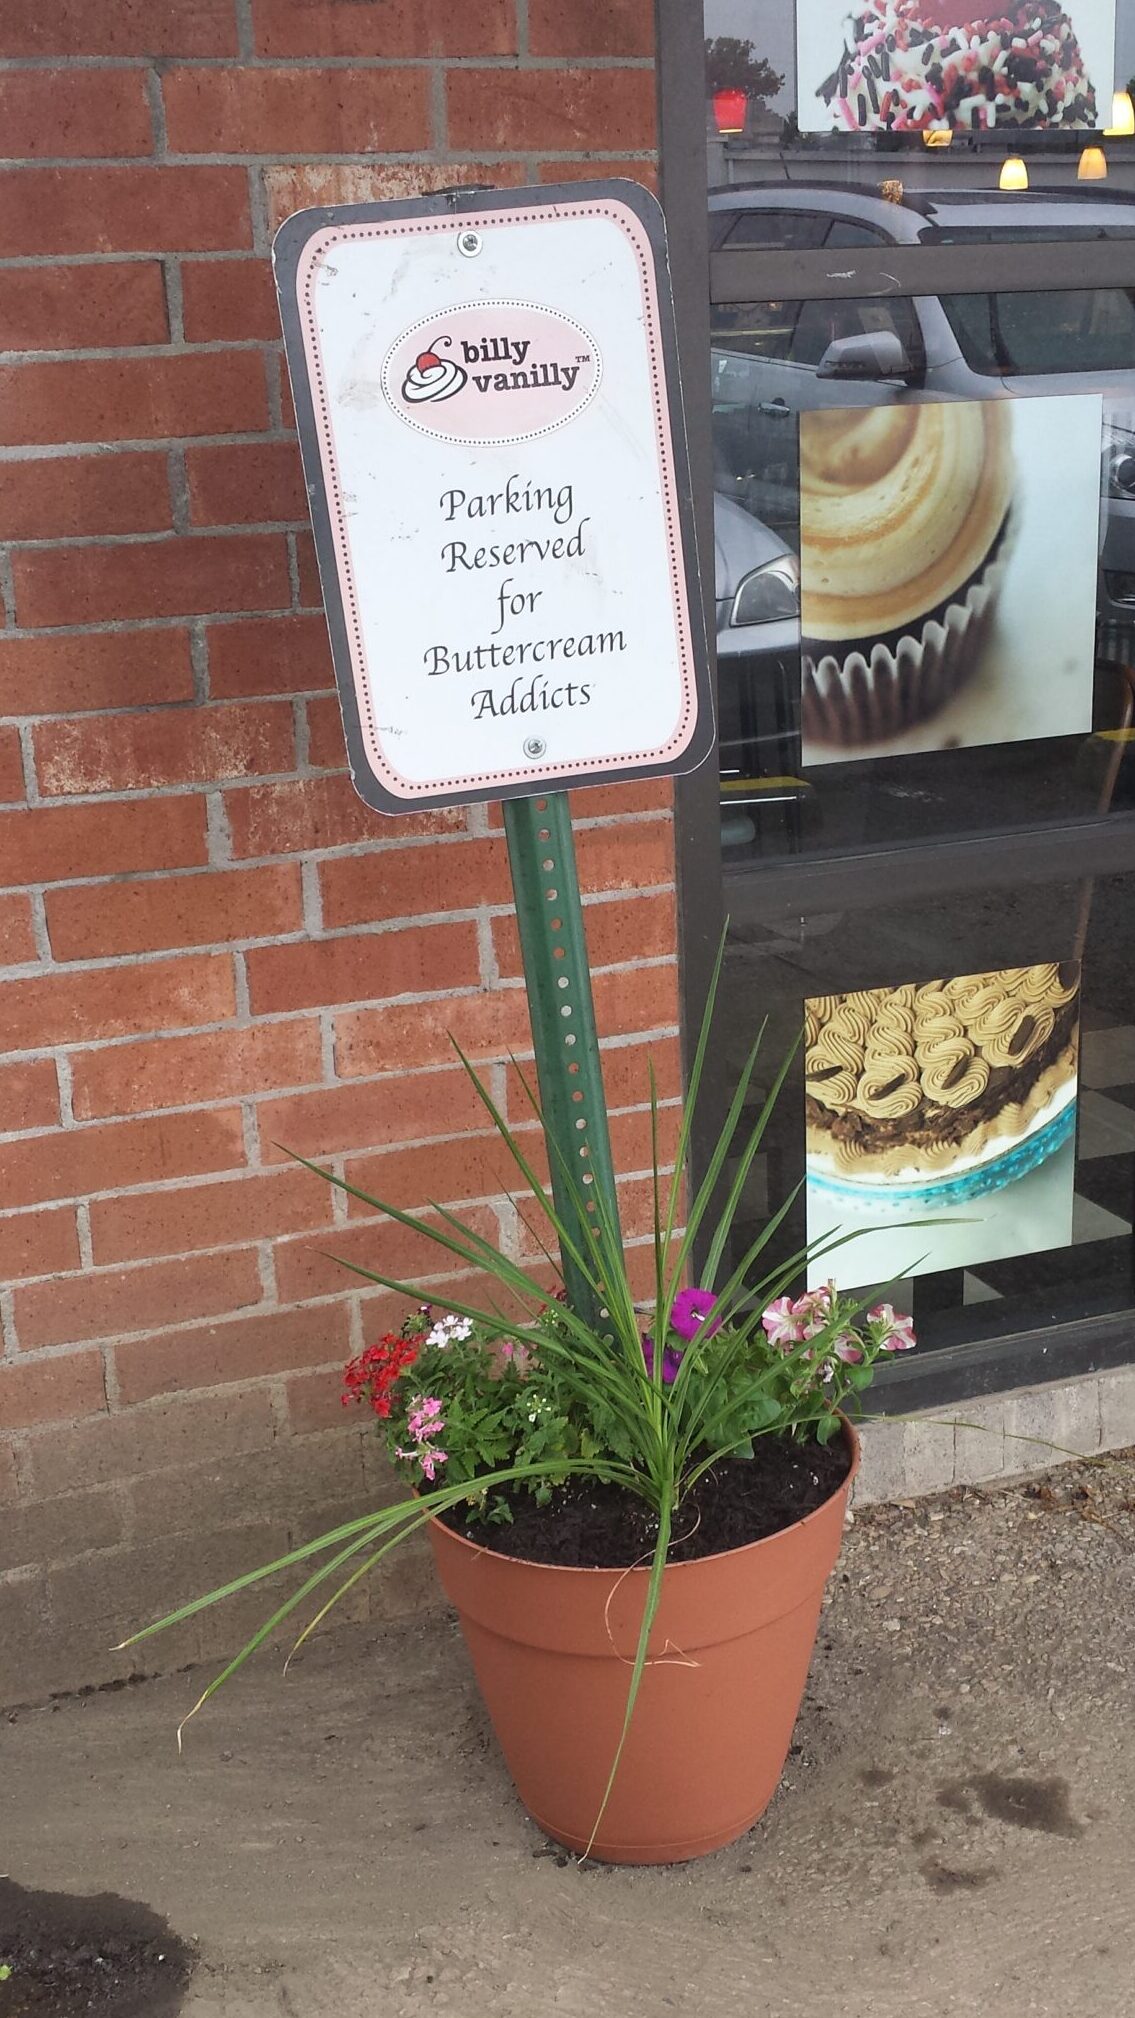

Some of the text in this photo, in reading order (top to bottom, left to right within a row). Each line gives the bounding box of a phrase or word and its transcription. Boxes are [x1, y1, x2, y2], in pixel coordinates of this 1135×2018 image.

[460, 337, 531, 365] billy
[472, 363, 580, 392] vanilly
[439, 474, 573, 525] Parking
[441, 517, 591, 573] Reserved
[490, 577, 543, 635] for
[423, 630, 627, 676] Buttercream
[470, 674, 591, 720] Addicts
